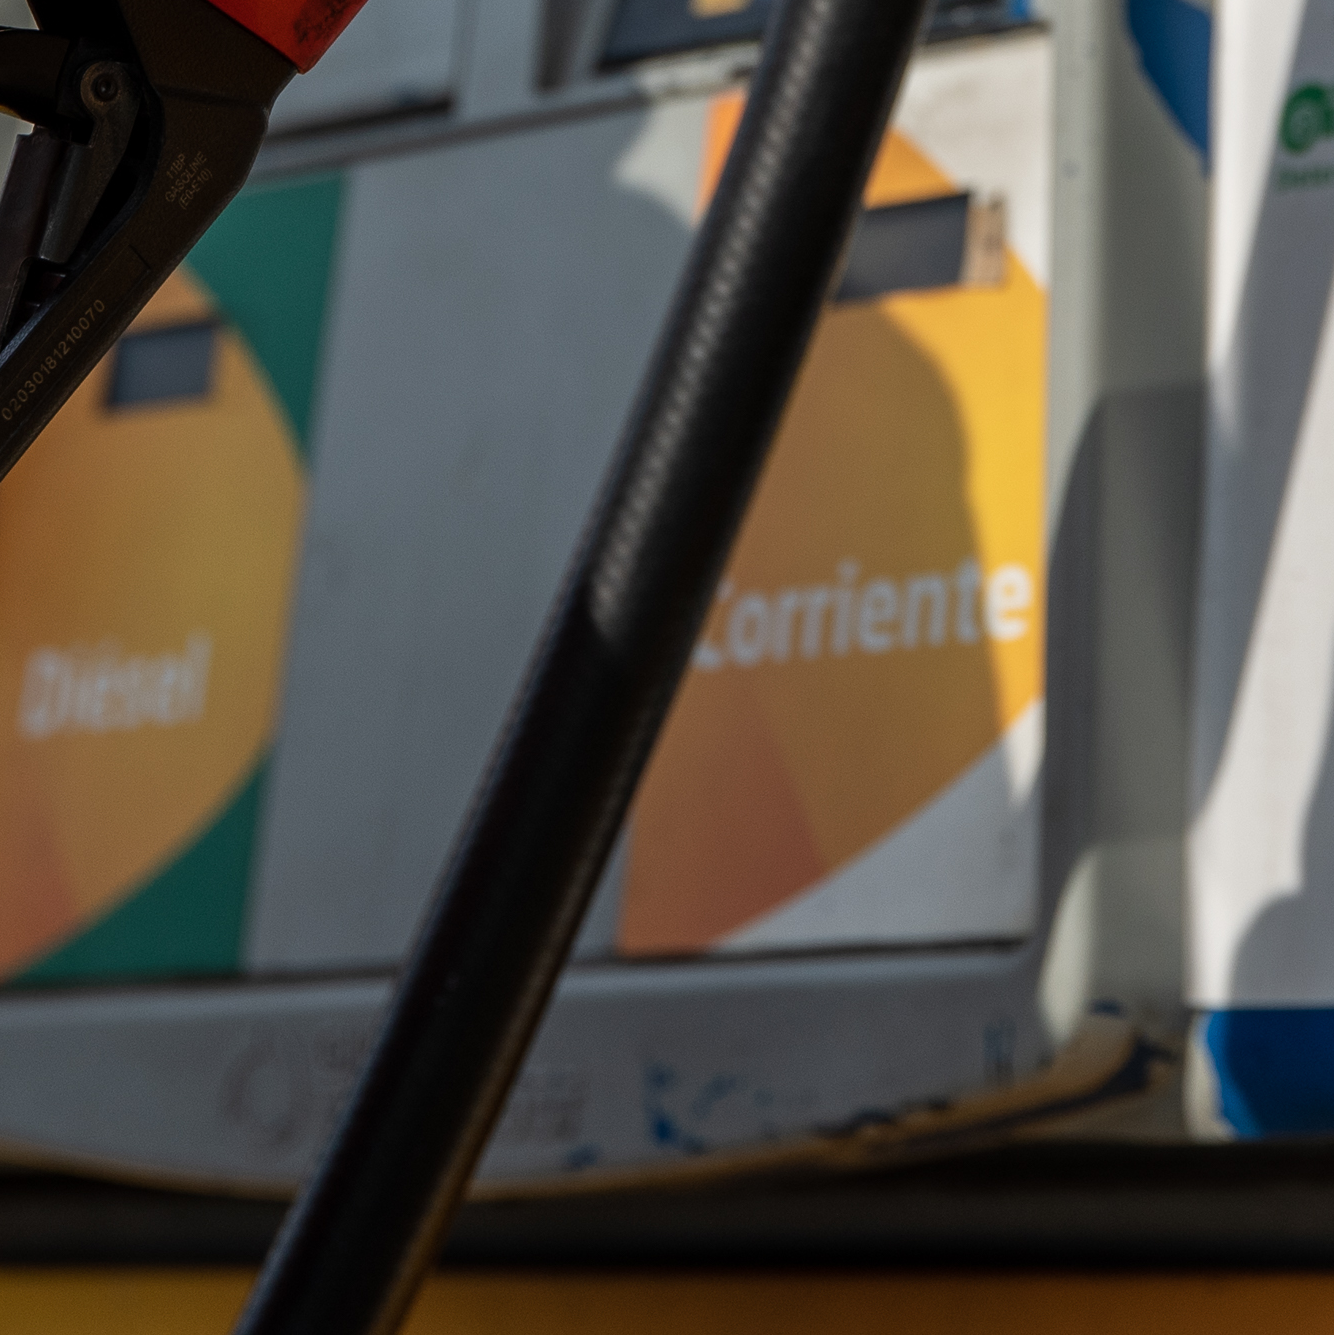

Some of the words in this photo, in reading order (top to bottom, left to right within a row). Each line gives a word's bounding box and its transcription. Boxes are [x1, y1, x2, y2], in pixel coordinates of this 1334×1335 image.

[165, 151, 208, 203] GASOLINE
[178, 167, 213, 210] (E0-E10)
[1, 299, 105, 421] 02030181210070
